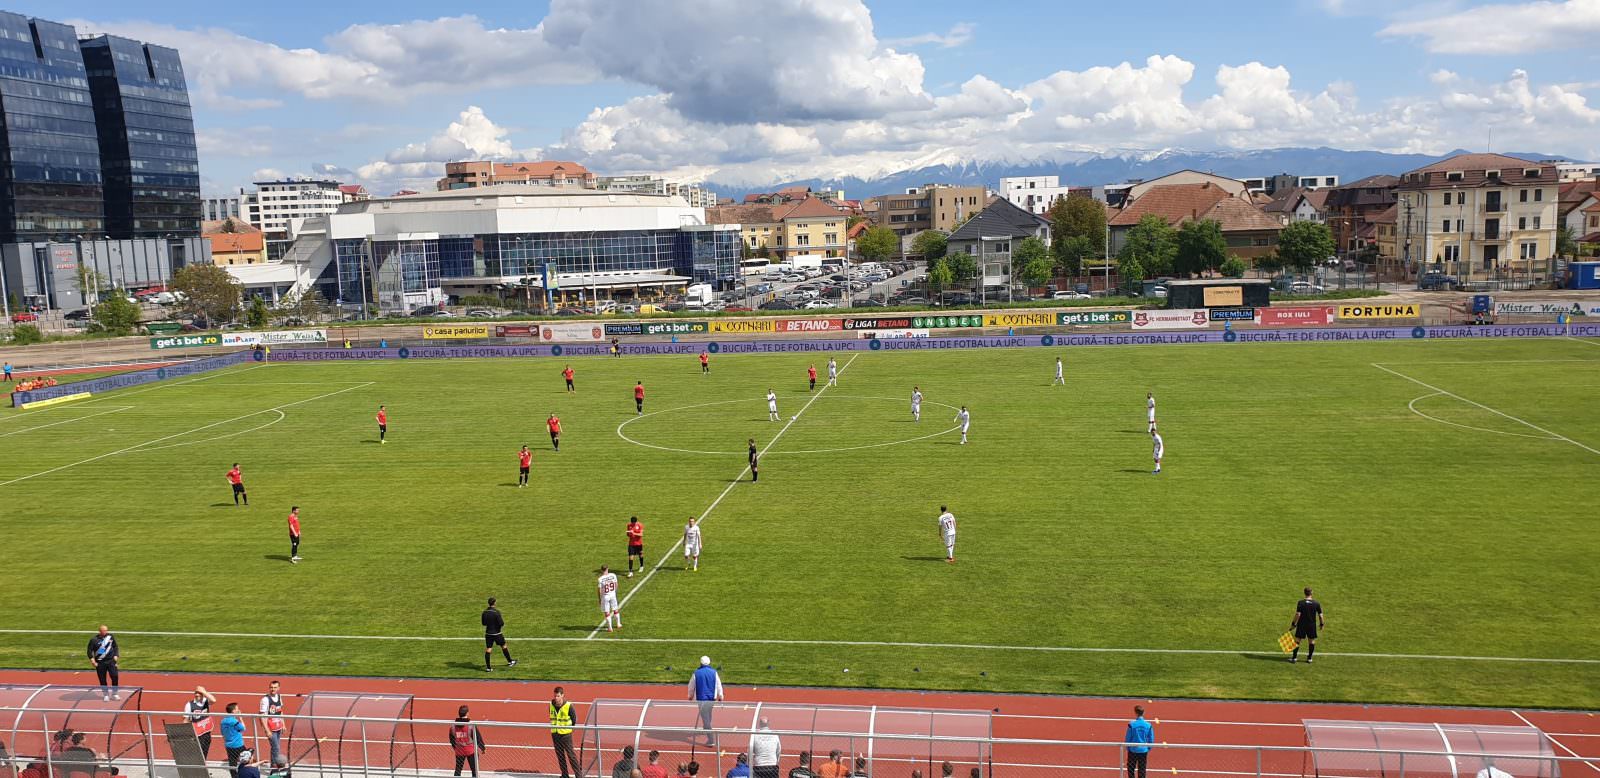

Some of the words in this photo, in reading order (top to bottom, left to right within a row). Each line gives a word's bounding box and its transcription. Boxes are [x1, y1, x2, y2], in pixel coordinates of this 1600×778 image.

[1342, 306, 1415, 316] FORTUNA
[1498, 302, 1534, 313] Mister
[1002, 313, 1053, 325] COTNARI
[1062, 312, 1090, 325] get's
[1212, 310, 1252, 318] PREMIUM
[1294, 311, 1311, 319] IULI
[726, 320, 772, 331] COTNARI
[877, 319, 909, 328] BETANO
[914, 316, 981, 328] UNIBET
[454, 326, 486, 337] pariurilor
[648, 323, 672, 334] get's
[1494, 328, 1509, 337] DE
[1511, 327, 1553, 337] FOTBAL
[1554, 326, 1568, 336] LA
[1571, 326, 1597, 336] UPC!
[1116, 336, 1130, 345] DE
[1131, 334, 1169, 345] FOTBAL
[1170, 334, 1183, 344] LA
[1183, 334, 1208, 343] UPC!
[1300, 331, 1314, 341] DE
[1316, 330, 1357, 341] FOTBAL
[1357, 330, 1370, 340] LA
[1371, 330, 1395, 339] UPC!
[156, 337, 183, 348] get's
[773, 344, 786, 352] DE
[788, 343, 822, 352] FOTBAL
[822, 343, 835, 351] LA
[835, 342, 855, 350] UPC!
[939, 340, 952, 349] DE
[953, 338, 990, 349] FOTBAL
[990, 339, 1002, 348] LA
[1004, 338, 1026, 347] UPC!
[313, 351, 325, 360] DE
[325, 350, 354, 360] FOTBAL
[355, 350, 366, 359] LA
[367, 349, 386, 359] UPC!
[474, 349, 506, 357] FOTBAL
[519, 348, 539, 356] UPC!
[630, 345, 662, 354] FOTBAL
[663, 345, 674, 353] LA
[675, 345, 695, 353] UPC!
[945, 520, 953, 530] 17
[604, 582, 615, 594] 69
